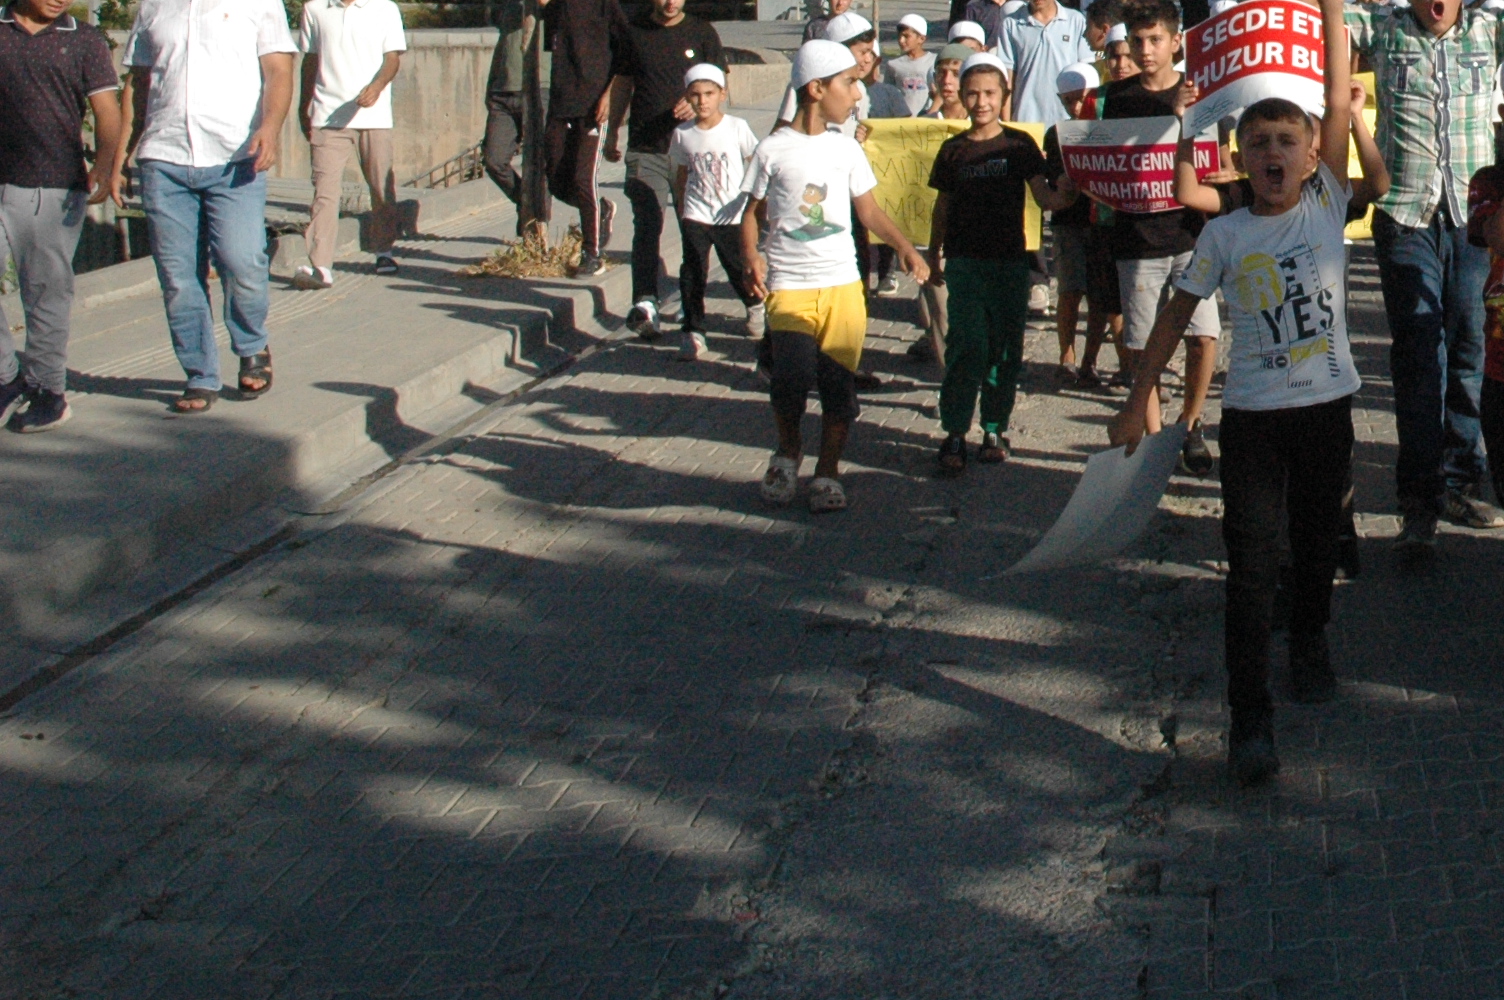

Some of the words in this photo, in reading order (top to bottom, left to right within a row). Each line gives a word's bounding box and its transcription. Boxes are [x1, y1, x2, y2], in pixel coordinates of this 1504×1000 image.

[1202, 7, 1286, 53] SECDE
[1193, 41, 1285, 89] HUZUR
[1069, 153, 1128, 172] NAMAZ
[1260, 288, 1335, 346] YES
